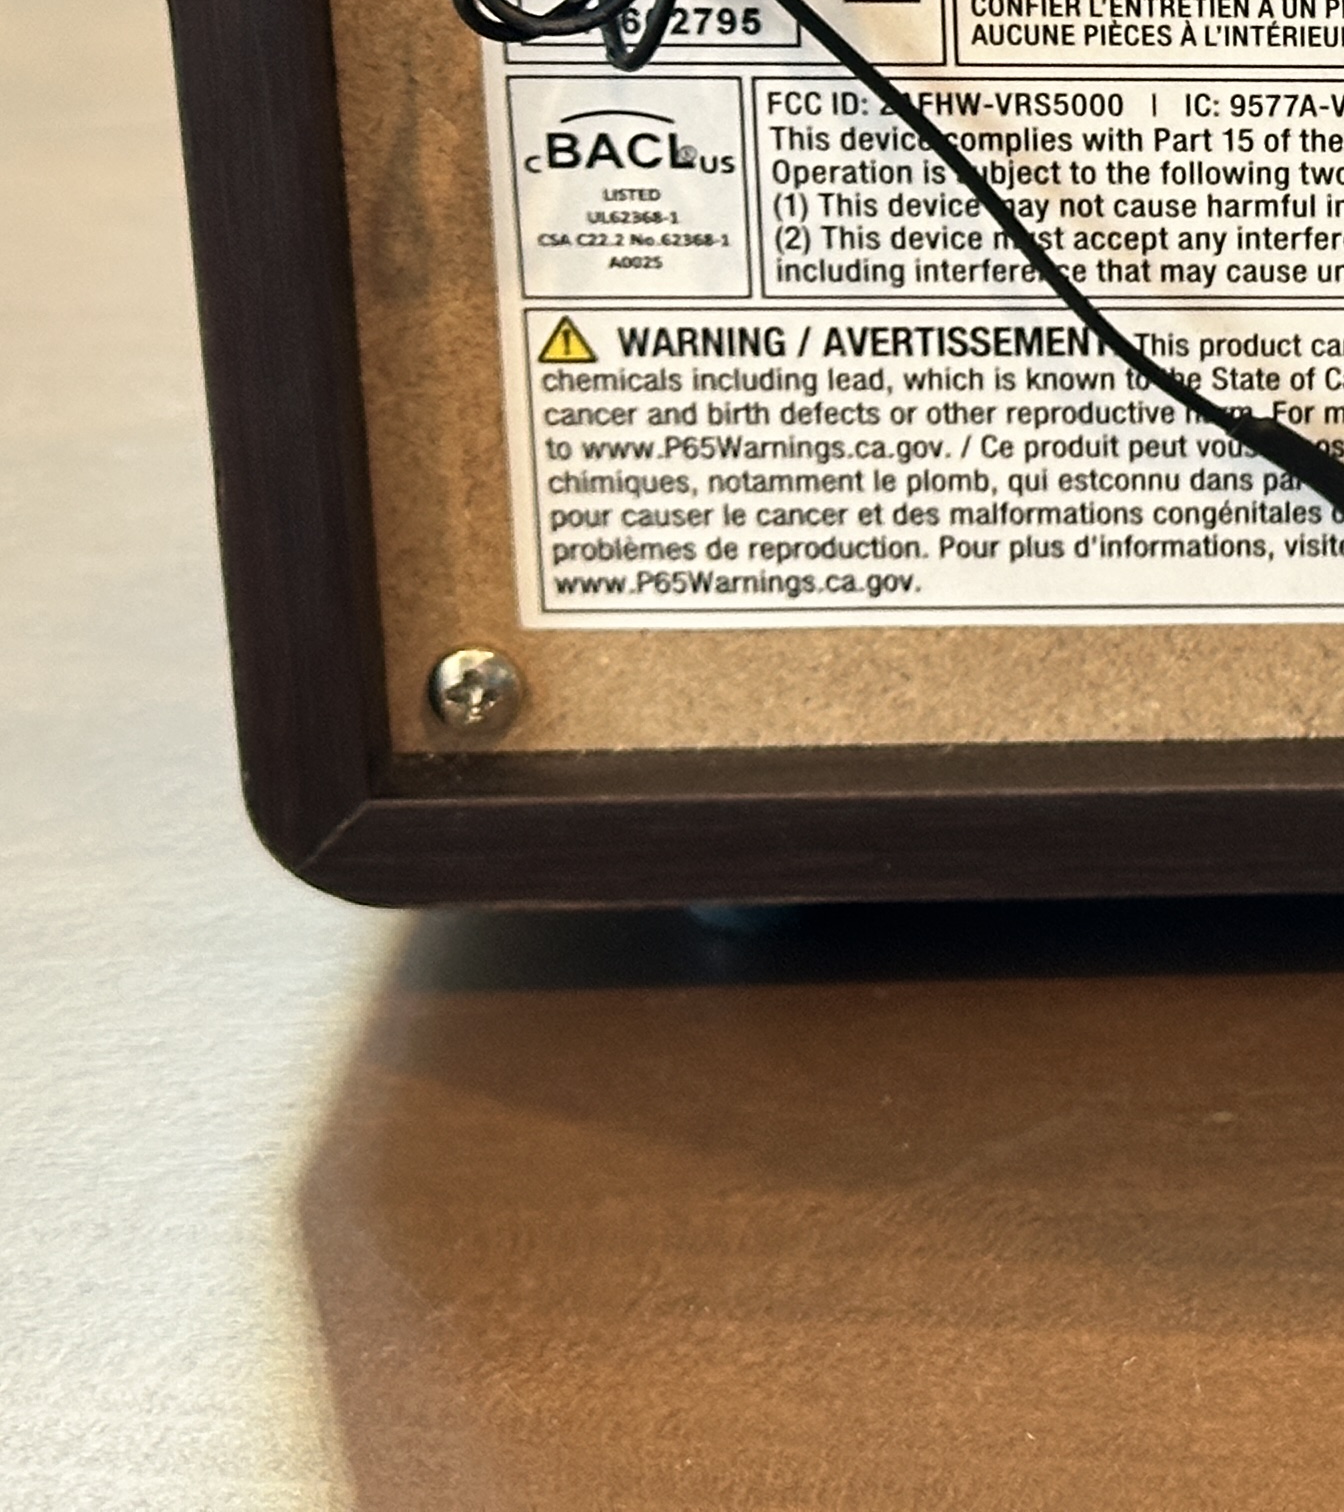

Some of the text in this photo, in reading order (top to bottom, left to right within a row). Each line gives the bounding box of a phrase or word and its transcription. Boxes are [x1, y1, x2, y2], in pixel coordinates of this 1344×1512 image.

[766, 91, 822, 116] FCC
[831, 91, 868, 116] ID:
[1185, 93, 1219, 117] IC:
[770, 125, 831, 151] This
[946, 127, 1073, 157] complies
[1082, 127, 1143, 152] with
[1154, 127, 1213, 152] Part
[1222, 128, 1254, 152] 15
[1264, 128, 1291, 153] of
[1299, 128, 1343, 153] the
[603, 188, 662, 202] LISTED
[587, 211, 679, 225] UL62368-1
[537, 234, 572, 248] CSA
[617, 326, 786, 357] WARNING
[1132, 332, 1191, 357] This
[1200, 333, 1302, 362] product
[552, 536, 697, 567] problèmes
[705, 537, 738, 561] de
[748, 535, 929, 565] reproduction.
[939, 535, 1001, 559] Pour
[1009, 535, 1065, 563] plus
[1074, 534, 1274, 561] d'informations,
[553, 570, 921, 599] www.P65Warnings.ca.gov.
